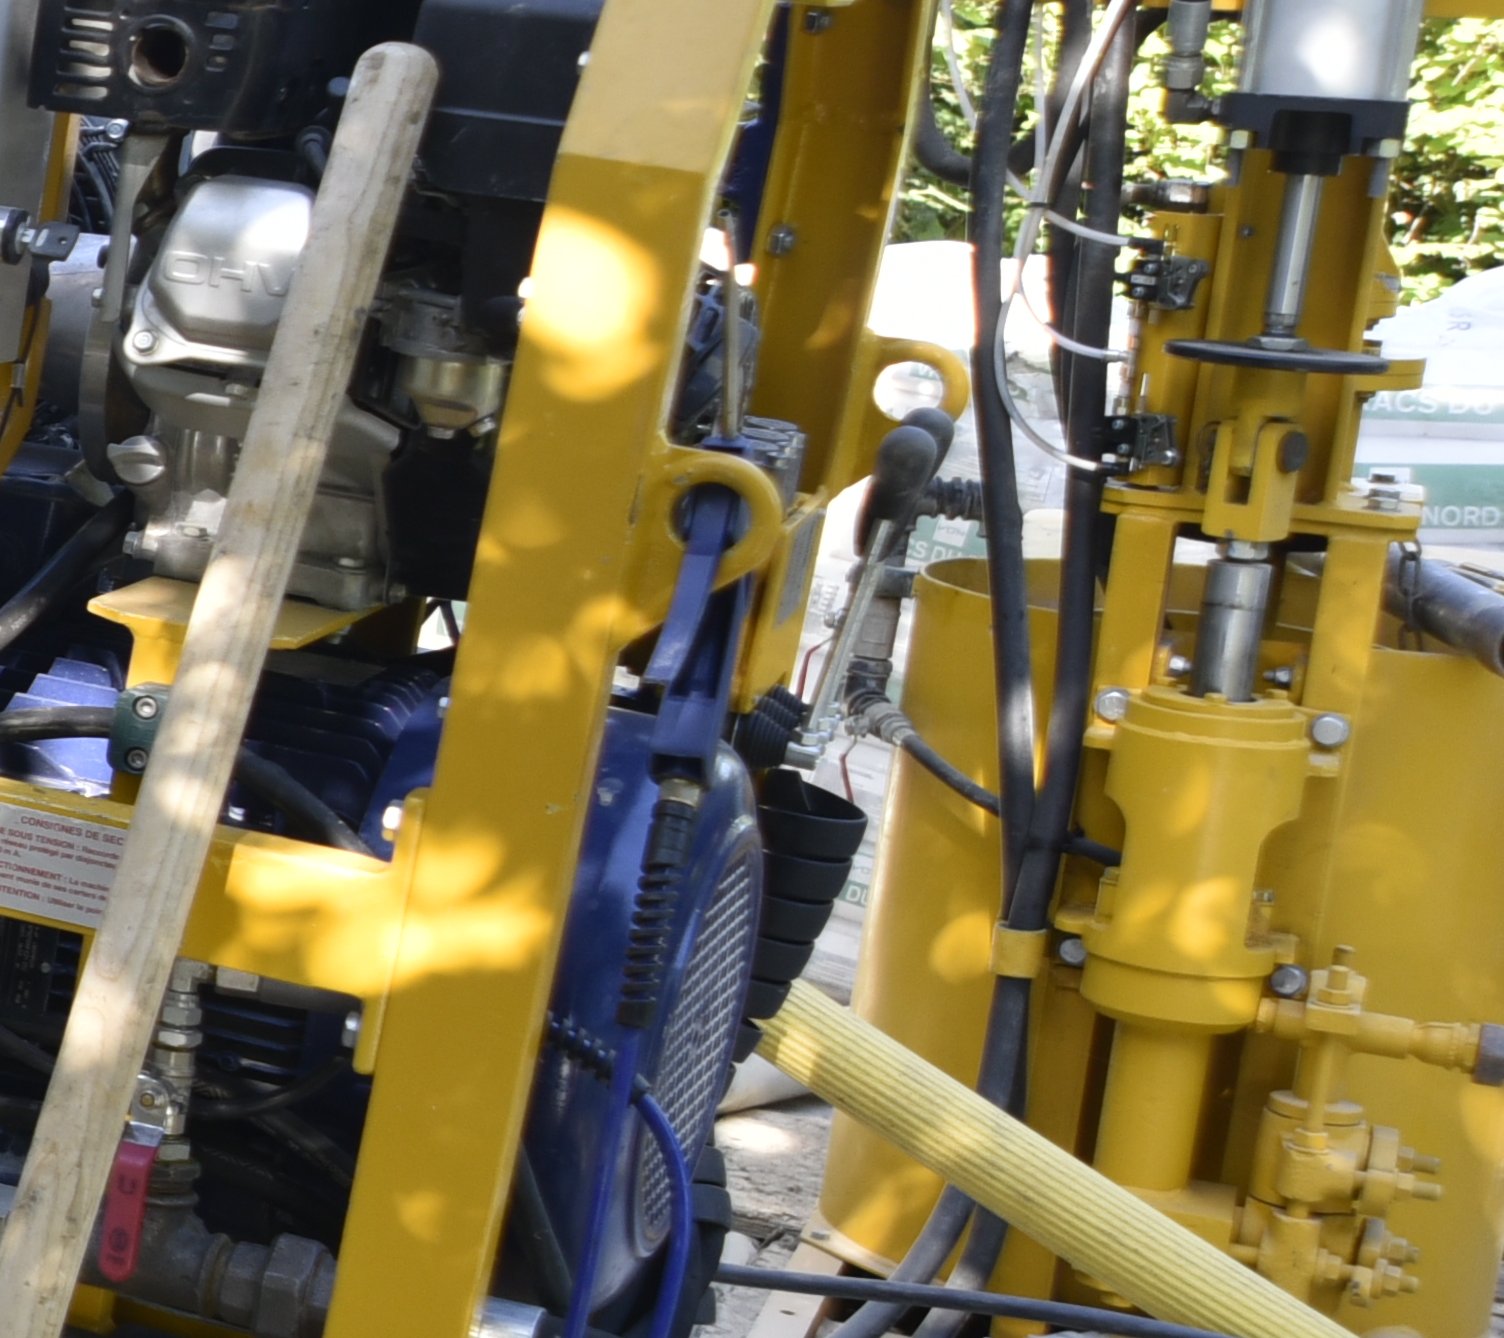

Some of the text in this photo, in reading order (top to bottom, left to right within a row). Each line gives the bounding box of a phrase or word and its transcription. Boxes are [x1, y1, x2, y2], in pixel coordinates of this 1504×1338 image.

[164, 250, 297, 297] OHV
[1422, 505, 1499, 527] NORD
[8, 828, 33, 841] SOUS
[35, 834, 76, 850] TENSION
[20, 815, 83, 837] CONSIGNES
[85, 830, 100, 841] DE
